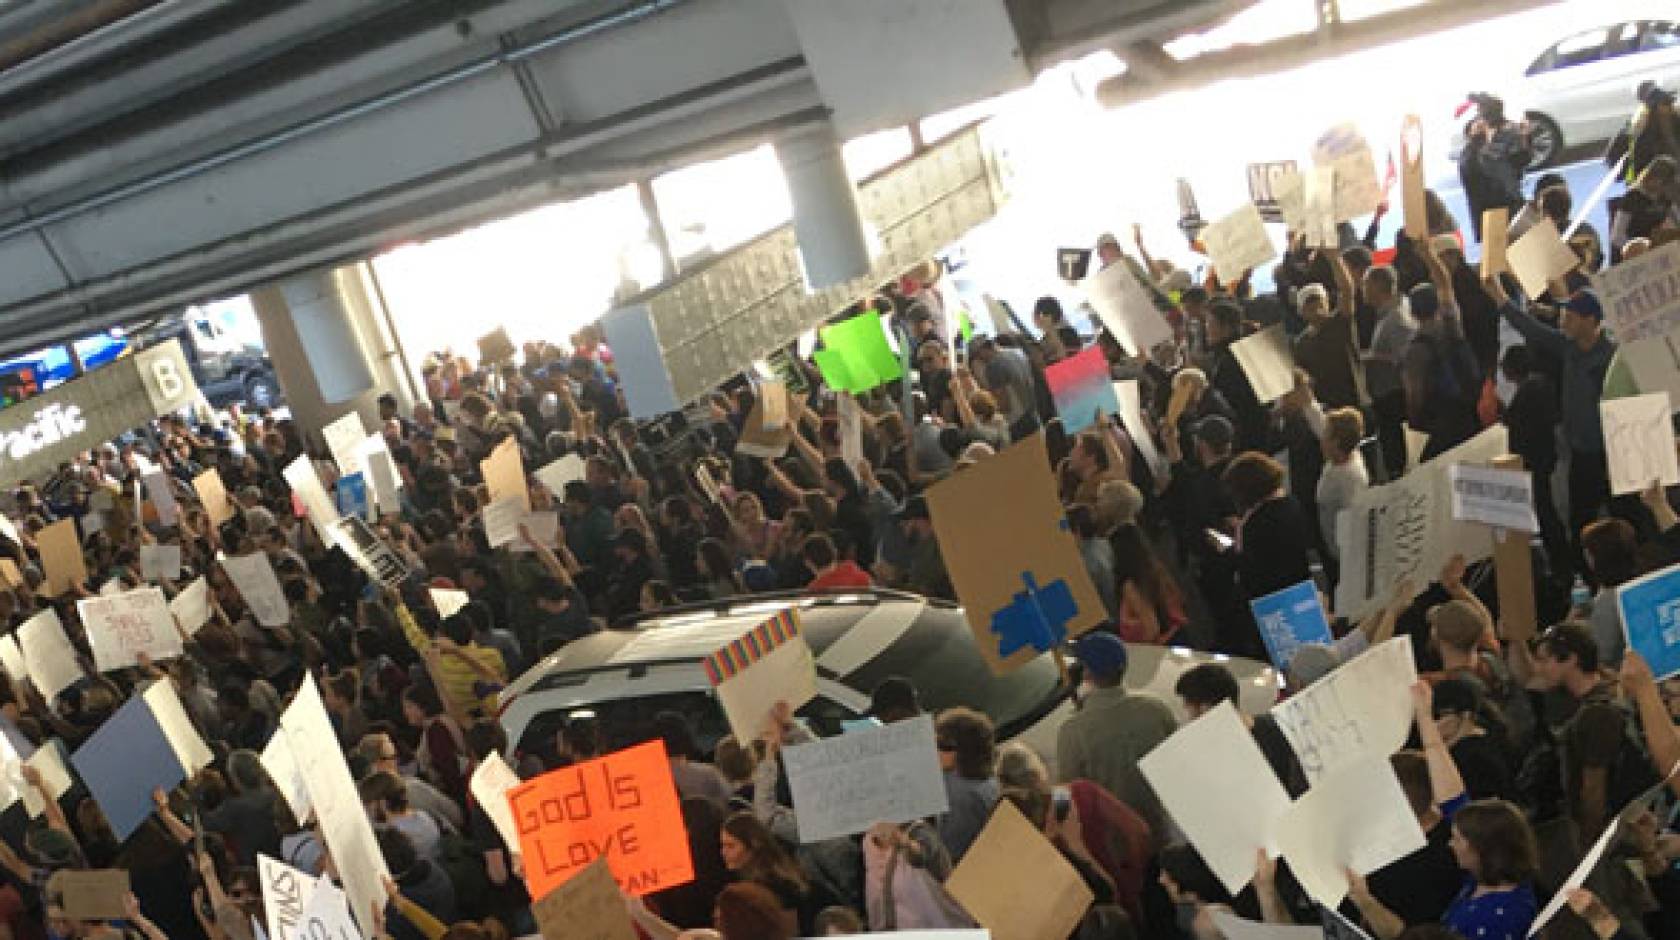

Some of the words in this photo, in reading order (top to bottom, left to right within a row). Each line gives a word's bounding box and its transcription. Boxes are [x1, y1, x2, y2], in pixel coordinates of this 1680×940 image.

[151, 357, 185, 400] B
[0, 402, 87, 458] acific
[510, 767, 593, 836] God
